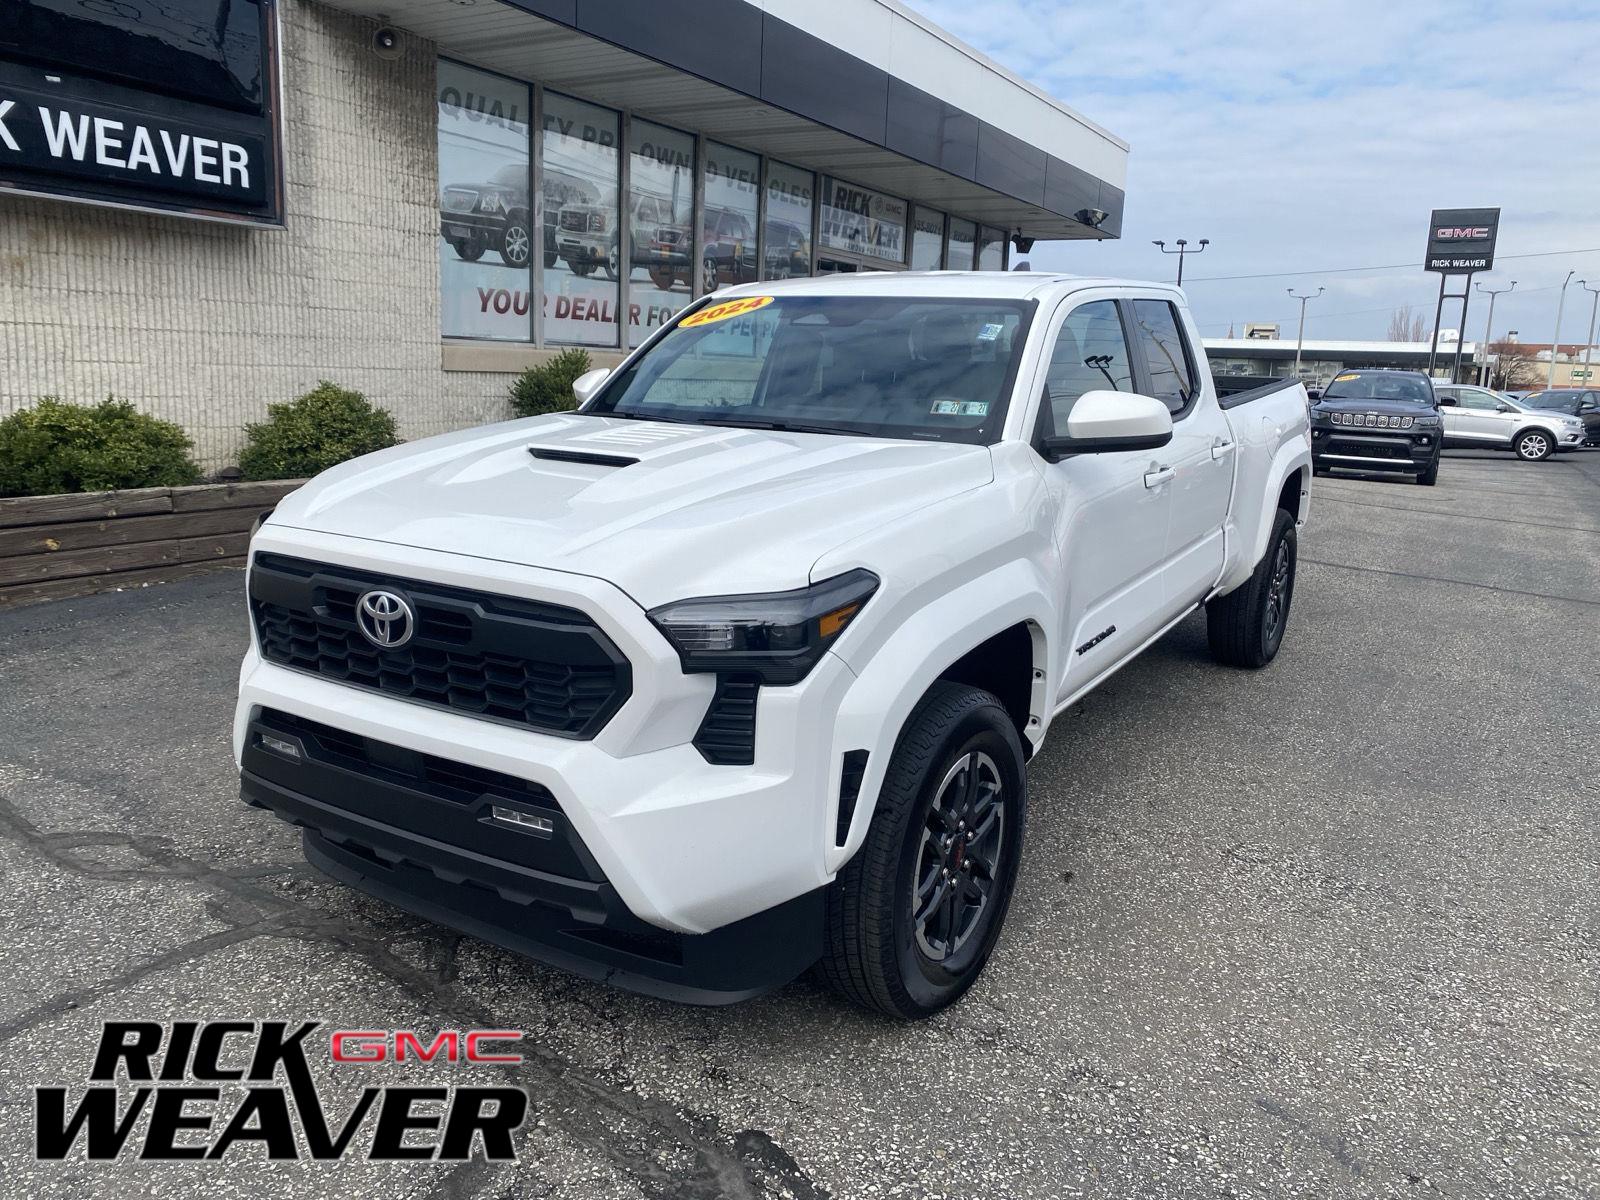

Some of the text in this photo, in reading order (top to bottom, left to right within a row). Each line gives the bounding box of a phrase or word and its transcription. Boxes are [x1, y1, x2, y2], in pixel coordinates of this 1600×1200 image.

[39, 106, 250, 189] WEAVER
[440, 86, 574, 145] QUALTY
[639, 142, 718, 183] OWND
[725, 163, 811, 208] VECLES
[834, 186, 873, 217] RICK
[823, 207, 900, 251] WEAVER
[1437, 228, 1489, 238] GMC
[1431, 259, 1486, 267] RICK WEAVER
[554, 295, 641, 326] DEALR
[646, 305, 685, 327] FO
[687, 298, 765, 325] 2024
